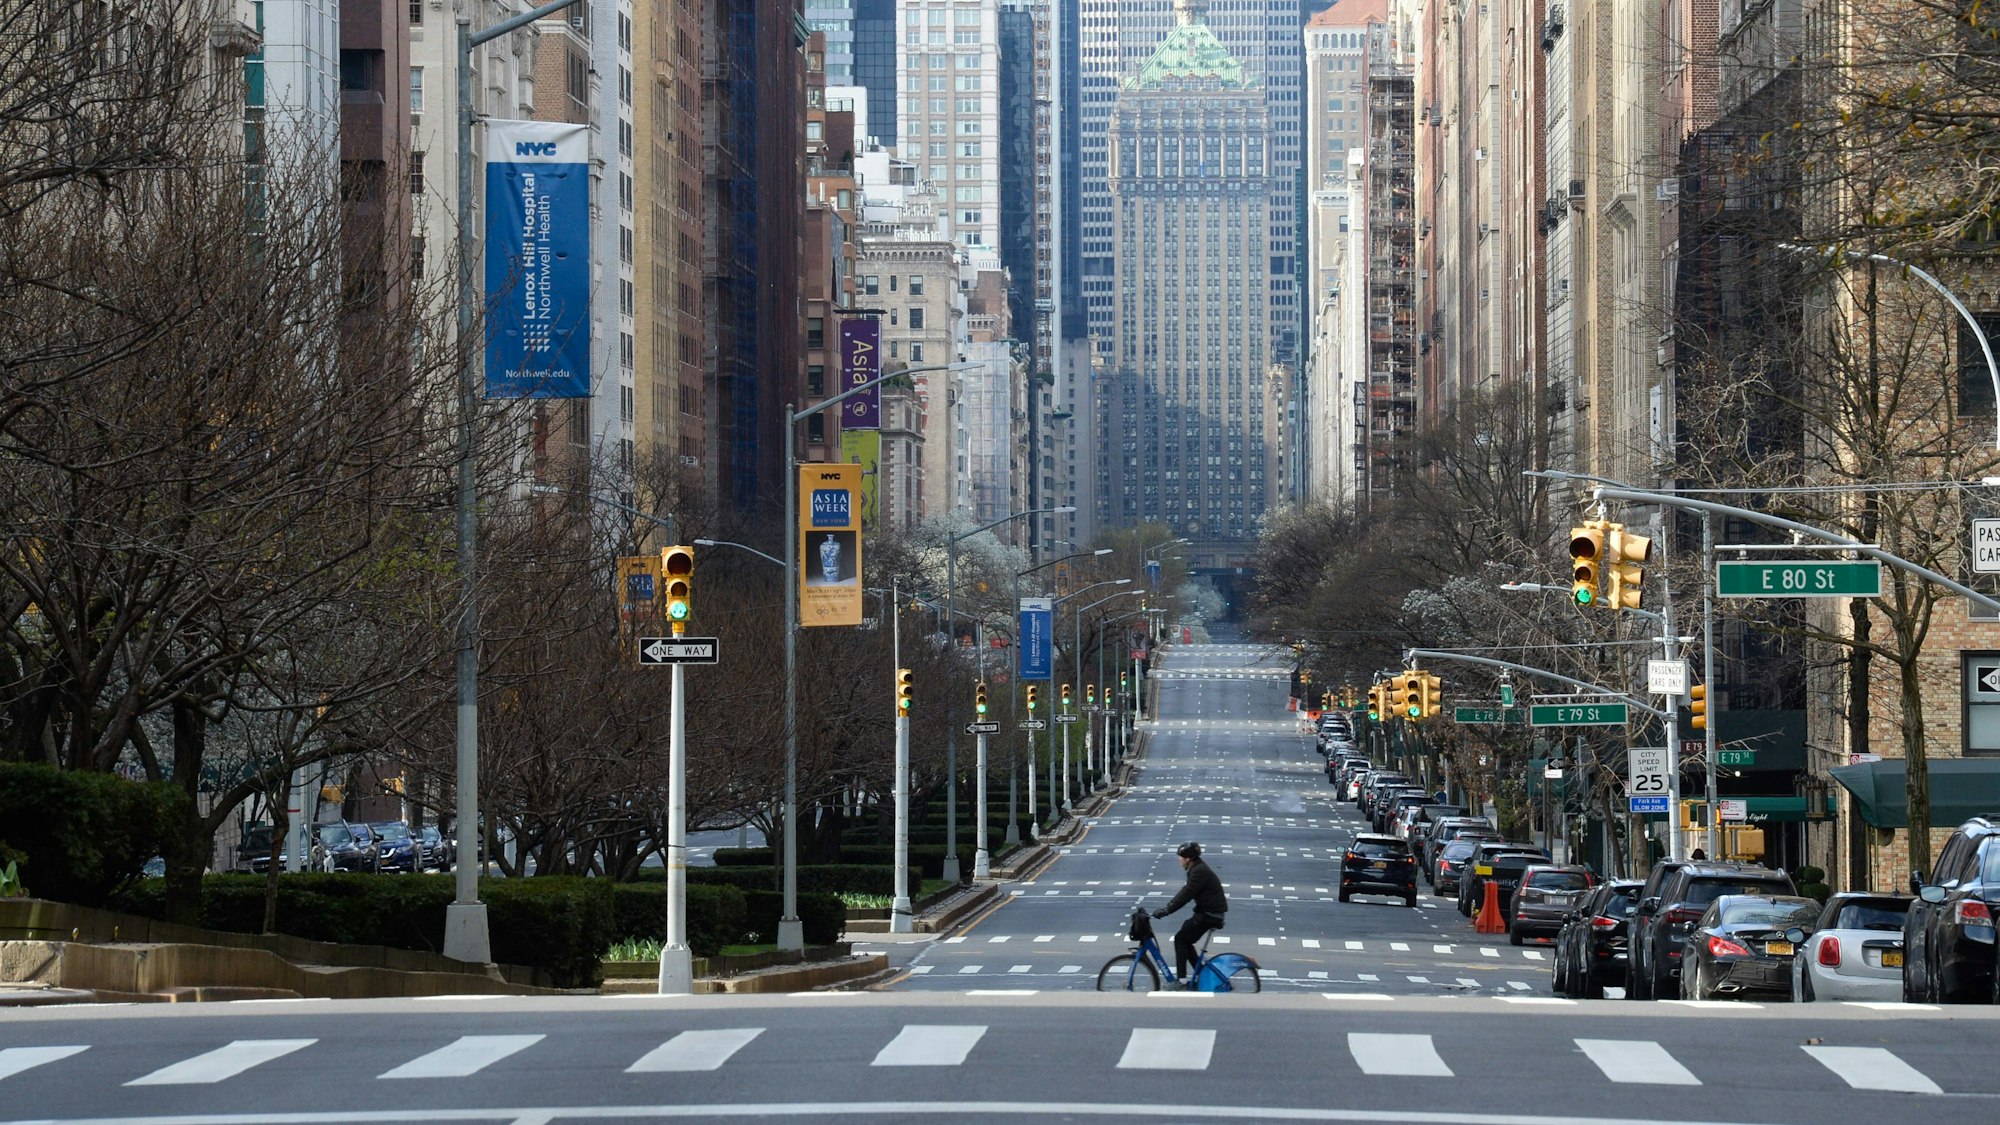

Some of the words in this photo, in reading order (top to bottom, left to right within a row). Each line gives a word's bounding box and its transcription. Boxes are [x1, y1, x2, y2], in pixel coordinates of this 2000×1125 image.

[516, 142, 557, 156] NYC
[522, 172, 537, 239] Hospital
[538, 195, 551, 243] Health
[523, 242, 535, 268] Hill
[538, 246, 551, 319] Northwell
[523, 271, 535, 320] Lenox
[853, 340, 873, 385] Asia
[814, 493, 847, 503] ASIA
[814, 503, 848, 513] WEEK
[1763, 569, 1773, 589] E
[1782, 569, 1807, 589] 80
[1815, 568, 1835, 589] St
[652, 646, 674, 656] ONE
[685, 646, 707, 655] WAY
[1651, 665, 1682, 675] PASSENGER
[1652, 677, 1665, 687] CARS
[1669, 678, 1682, 688] ONLY
[1558, 709, 1565, 721] E
[1570, 708, 1583, 720] 79
[1588, 708, 1600, 720] St
[1693, 742, 1702, 750] 79
[1722, 753, 1726, 762] E
[1730, 752, 1740, 762] 79
[1636, 774, 1663, 791] 25
[1749, 813, 1768, 822] Eight
